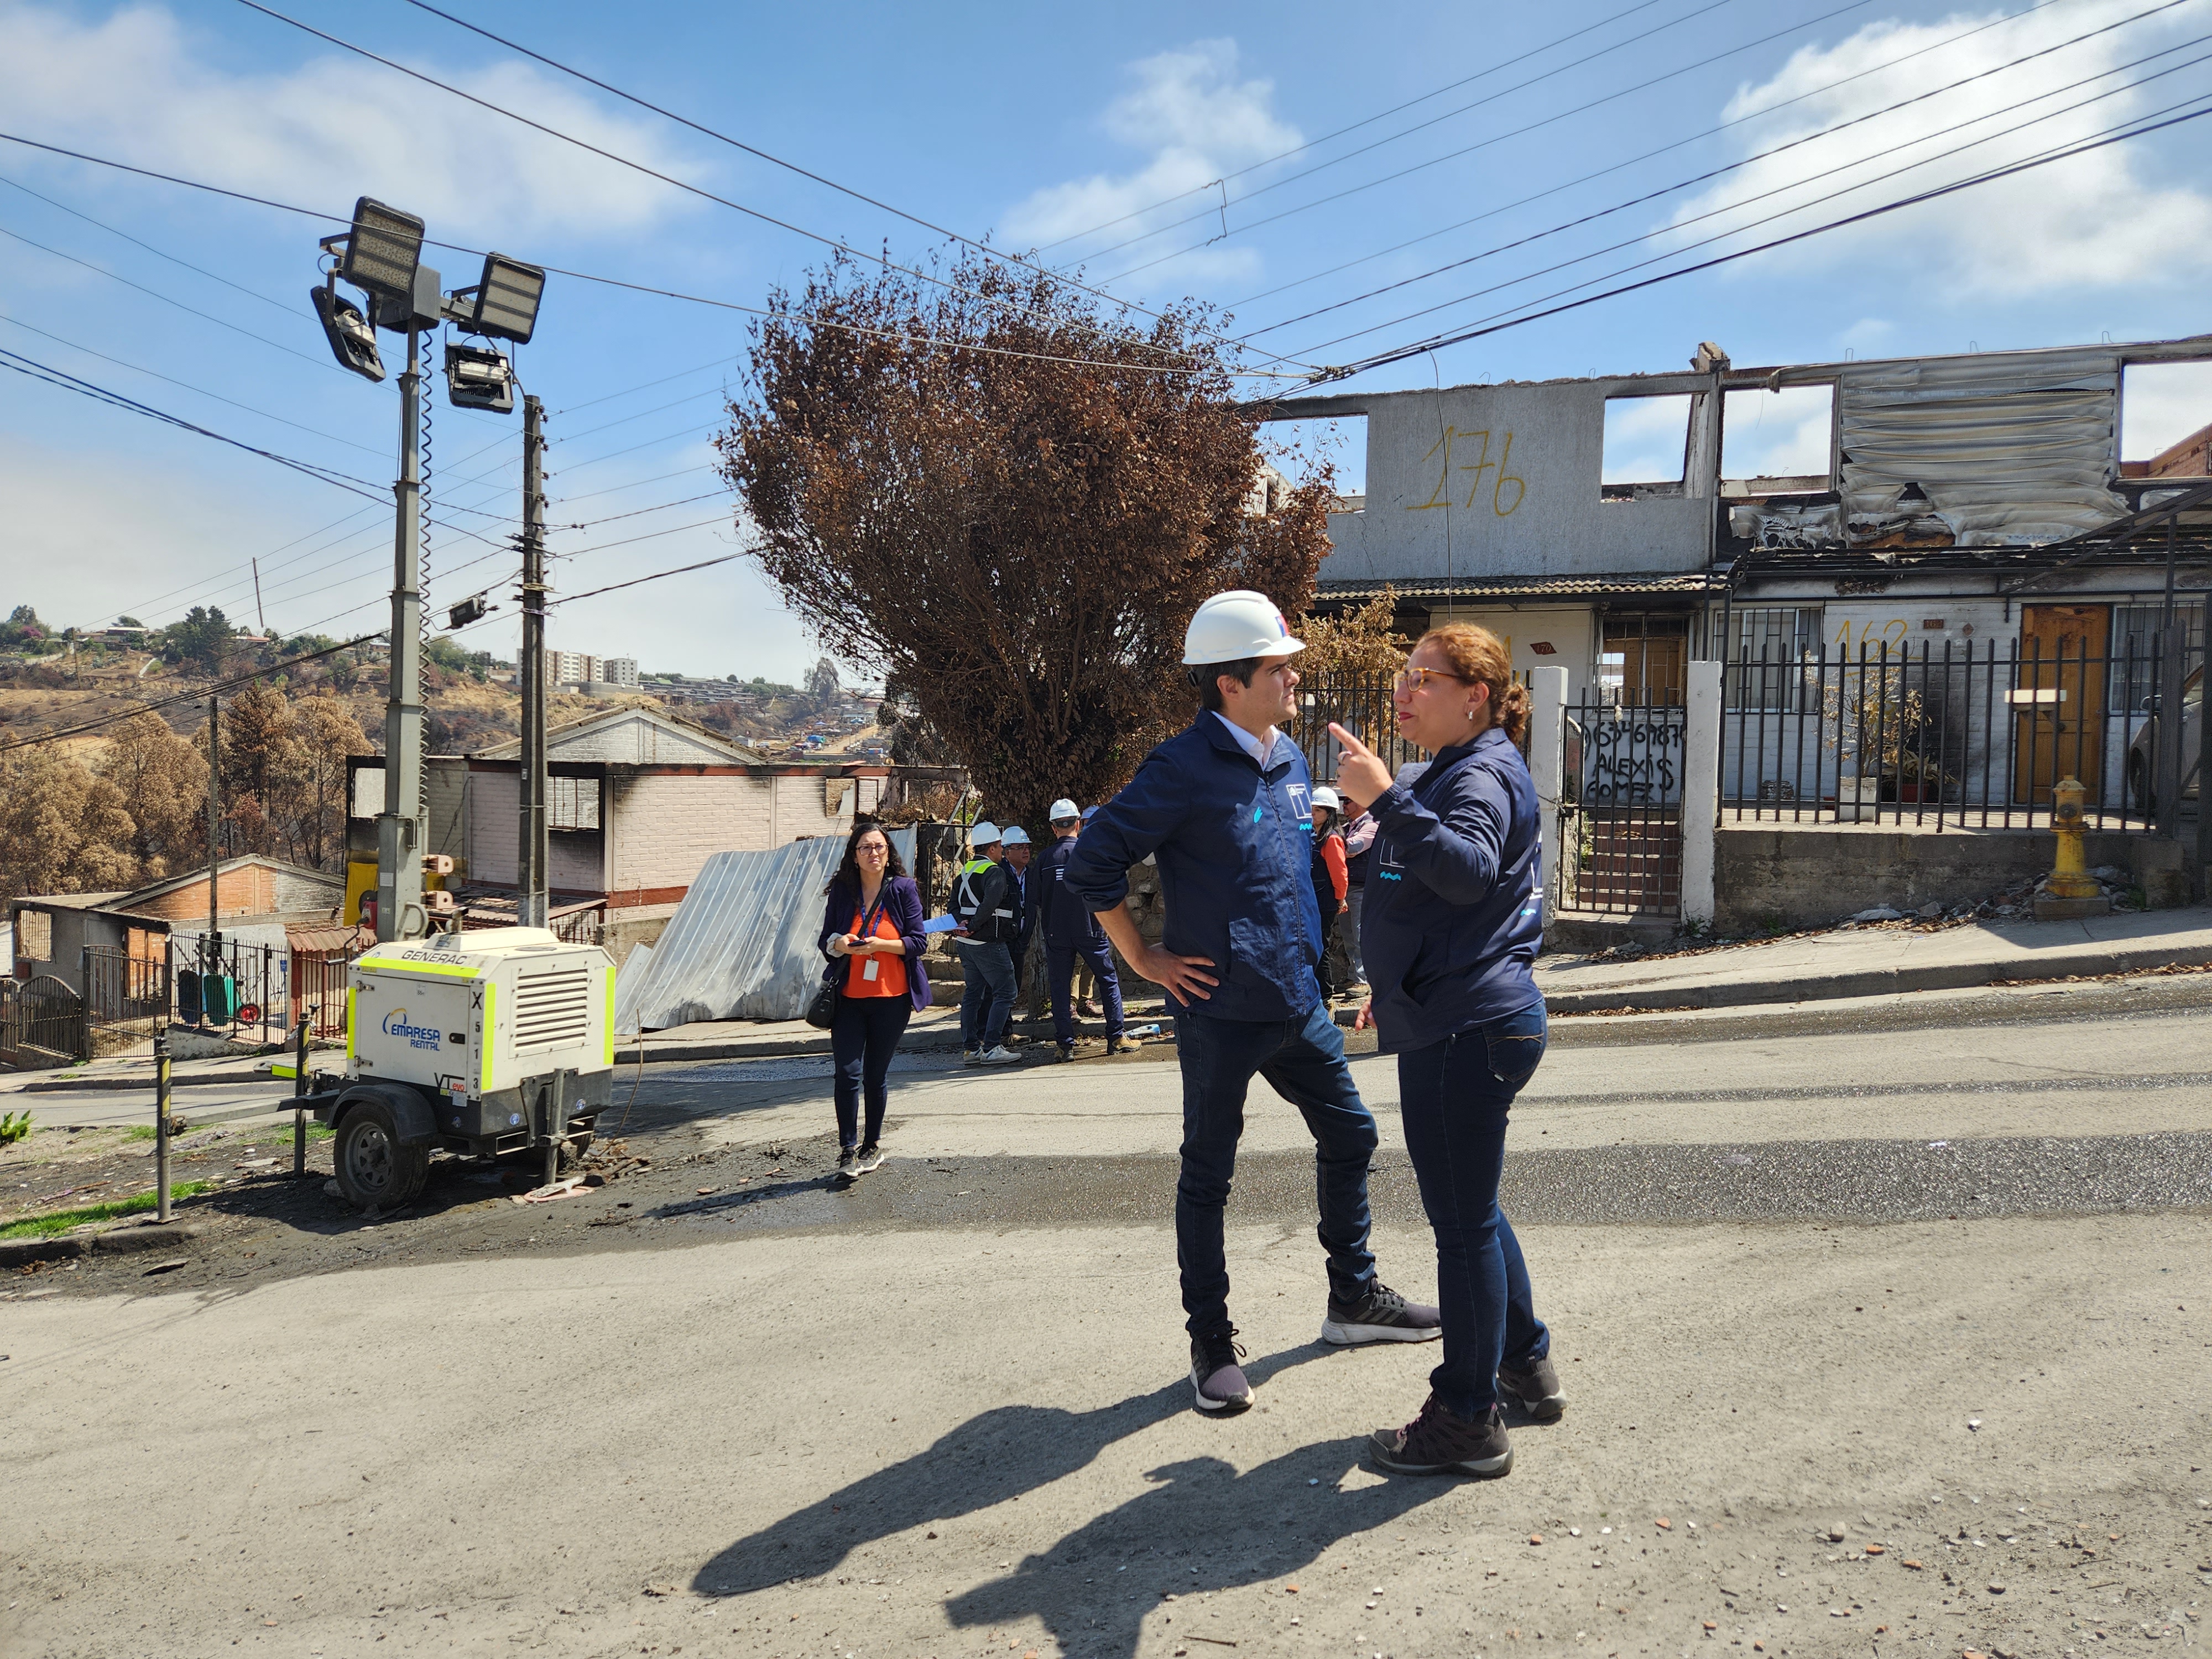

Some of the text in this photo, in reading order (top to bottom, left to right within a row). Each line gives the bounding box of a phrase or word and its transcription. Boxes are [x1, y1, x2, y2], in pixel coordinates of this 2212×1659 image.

[1406, 425, 1525, 517] 176
[1835, 619, 1923, 663] 162
[401, 950, 467, 964] GENERAC
[391, 1024, 440, 1042] EMARESA
[410, 1039, 440, 1051] RENTAL
[452, 1083, 465, 1092] evo
